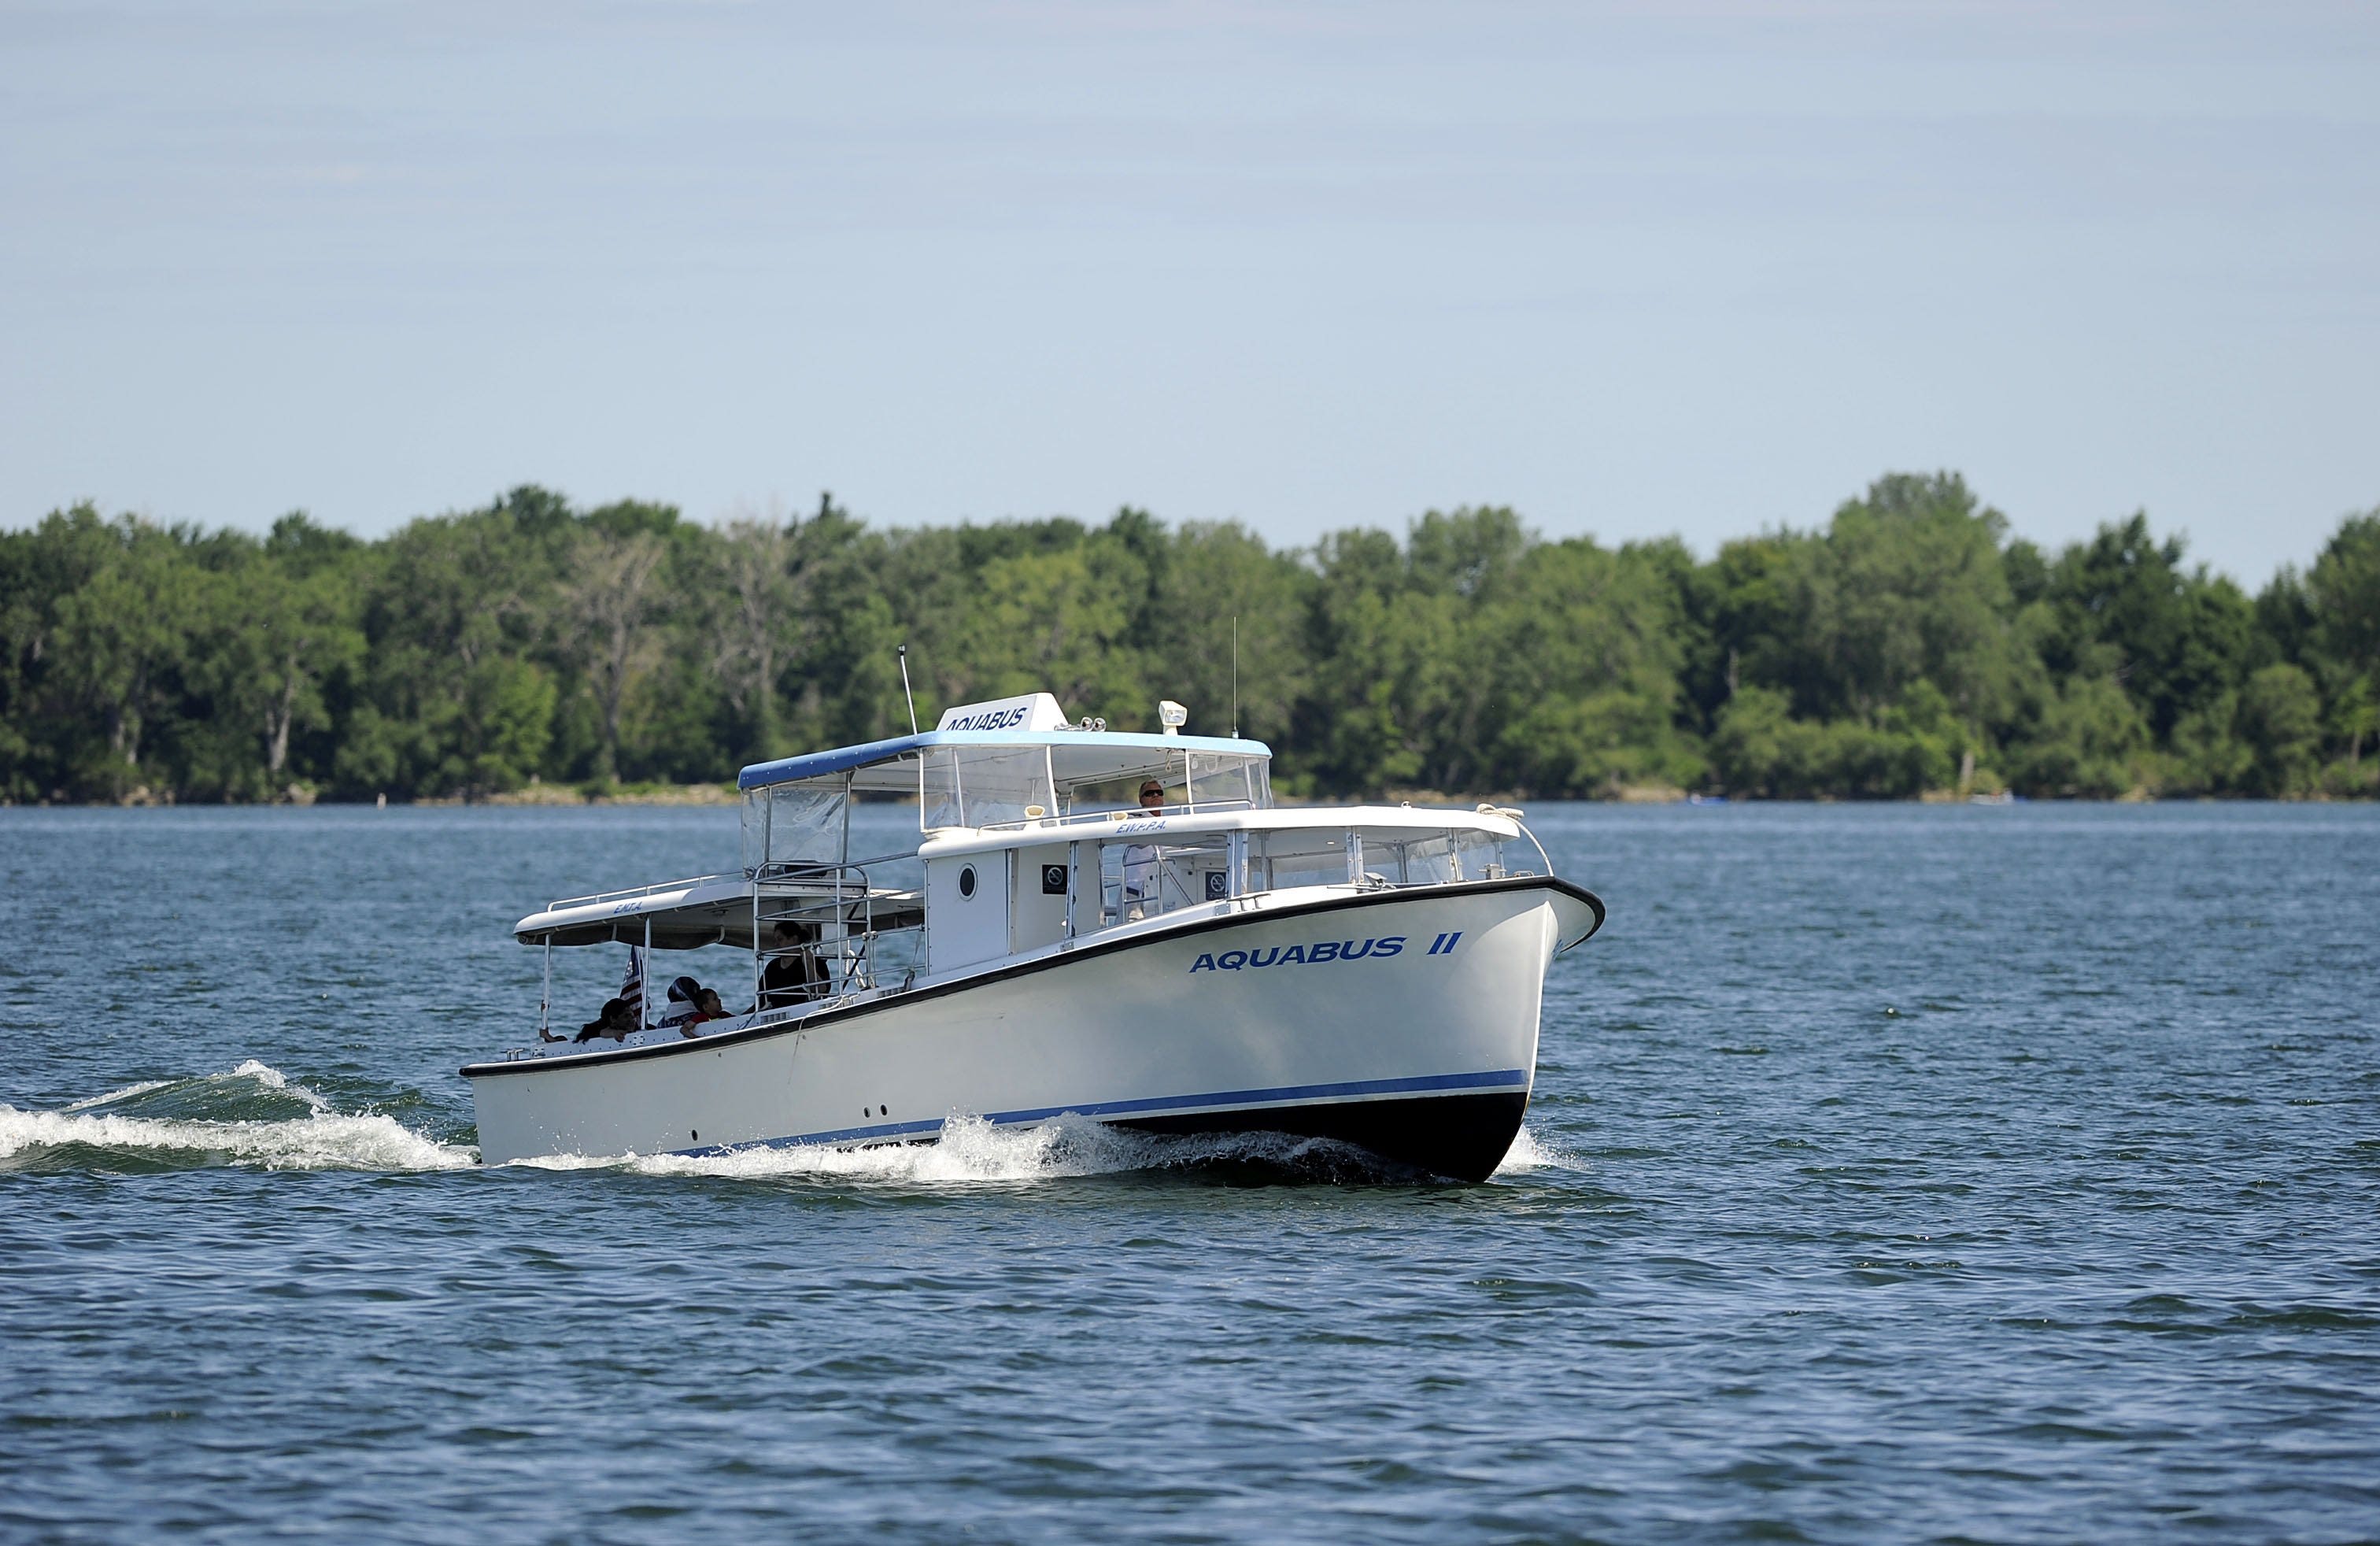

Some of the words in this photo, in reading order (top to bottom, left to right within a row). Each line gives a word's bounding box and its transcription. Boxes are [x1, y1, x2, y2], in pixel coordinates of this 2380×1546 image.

[946, 707, 1027, 730] AQUABUS
[1189, 937, 1407, 973] AQUABUS
[1427, 932, 1464, 955] II
